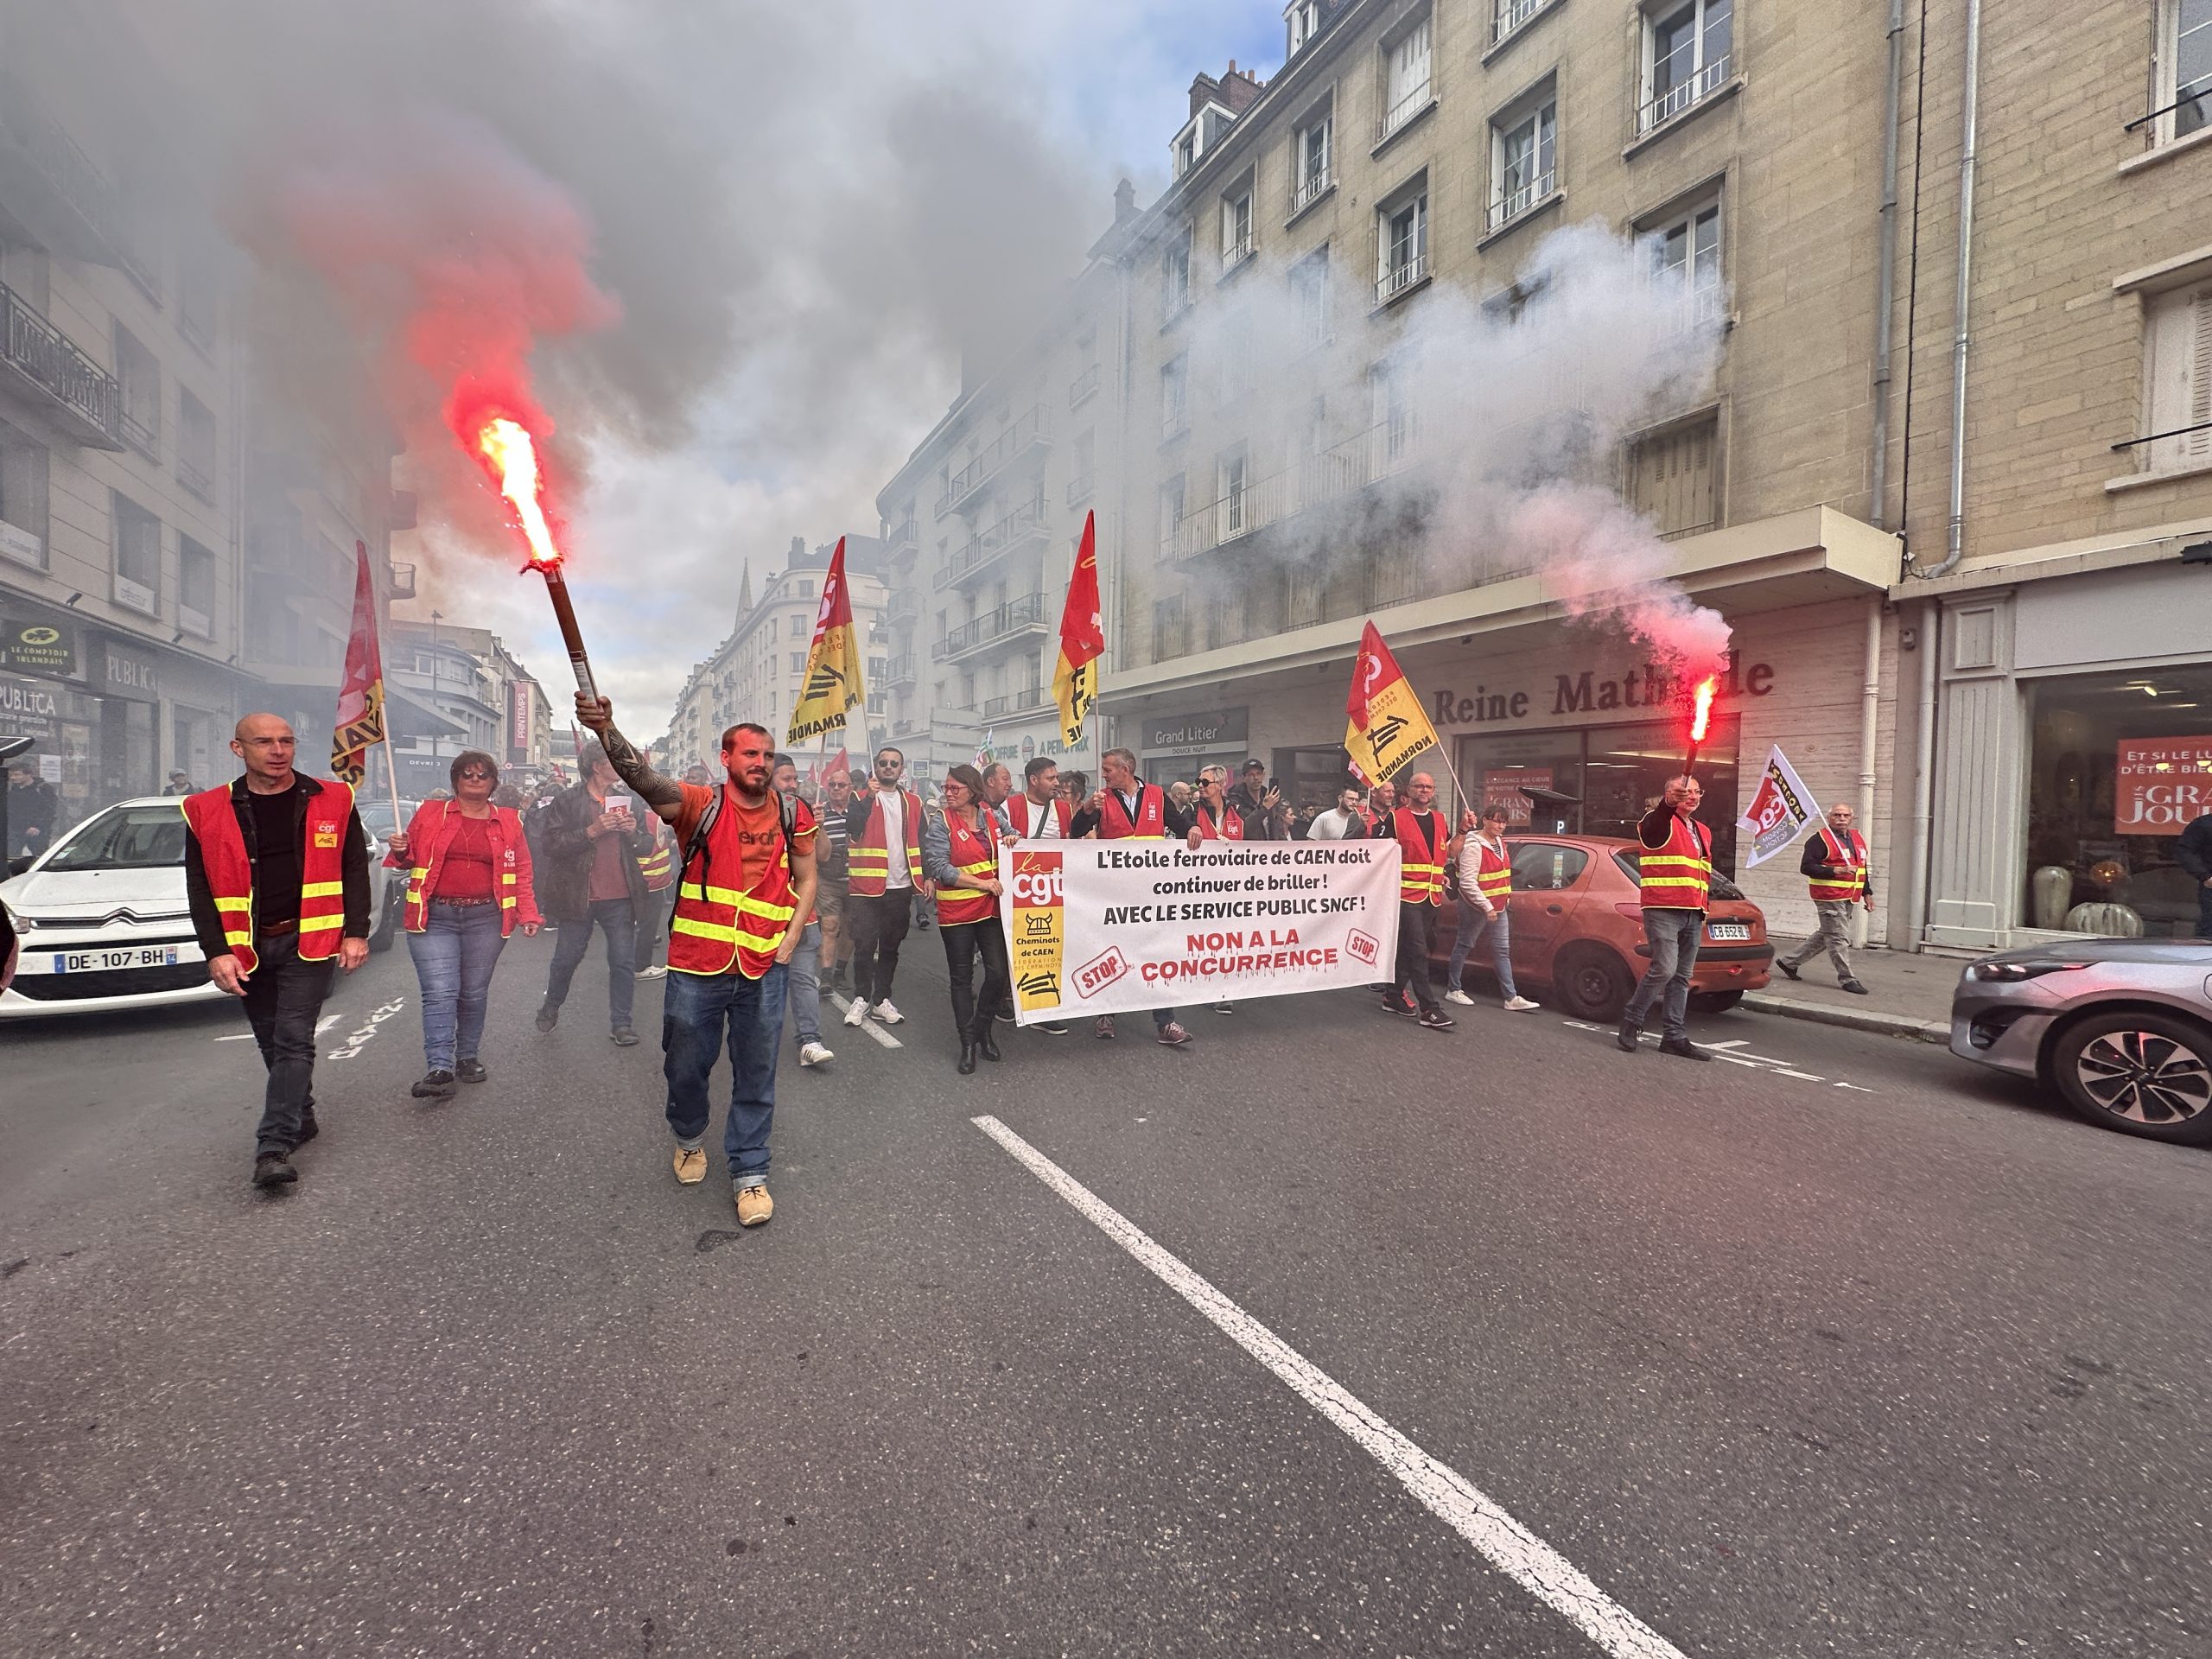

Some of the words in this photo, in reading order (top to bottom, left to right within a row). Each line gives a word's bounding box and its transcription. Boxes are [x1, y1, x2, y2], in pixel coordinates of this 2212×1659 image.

[16, 657, 63, 665] IRLANDAIS
[24, 647, 68, 657] COMPTOIR
[1433, 685, 1529, 725] Reine
[1551, 650, 1774, 715] Mathe
[518, 692, 526, 739] PRINTEMPS
[1155, 728, 1184, 744] Grand
[1188, 727, 1217, 741] Litier
[2127, 751, 2147, 760] ET
[2172, 751, 2190, 760] LE
[2181, 765, 2212, 773] BIE
[1493, 797, 1535, 809] GRAN
[2116, 800, 2212, 824] JOU
[318, 823, 336, 834] cgt
[1379, 825, 1386, 836] 3
[1556, 821, 1565, 835] P
[1097, 849, 1170, 868] L'Etoile
[1173, 848, 1268, 868] ferroviaire
[1270, 850, 1291, 865] de
[1294, 849, 1336, 865] CAEN
[1338, 848, 1372, 864] doit
[1013, 867, 1064, 906] cgt
[1153, 875, 1241, 894] continuer
[1243, 875, 1264, 891] de
[1103, 906, 1153, 925] AVEC
[1155, 905, 1178, 922] LE
[1180, 901, 1253, 920] SERVICE
[1256, 899, 1318, 916] PUBLIC
[1186, 931, 1243, 955] NON
[1249, 931, 1265, 949] A
[1270, 928, 1300, 948] LA
[1351, 936, 1375, 958] STOP
[1081, 955, 1119, 989] STOP
[1141, 948, 1338, 984] CONCURRENCE
